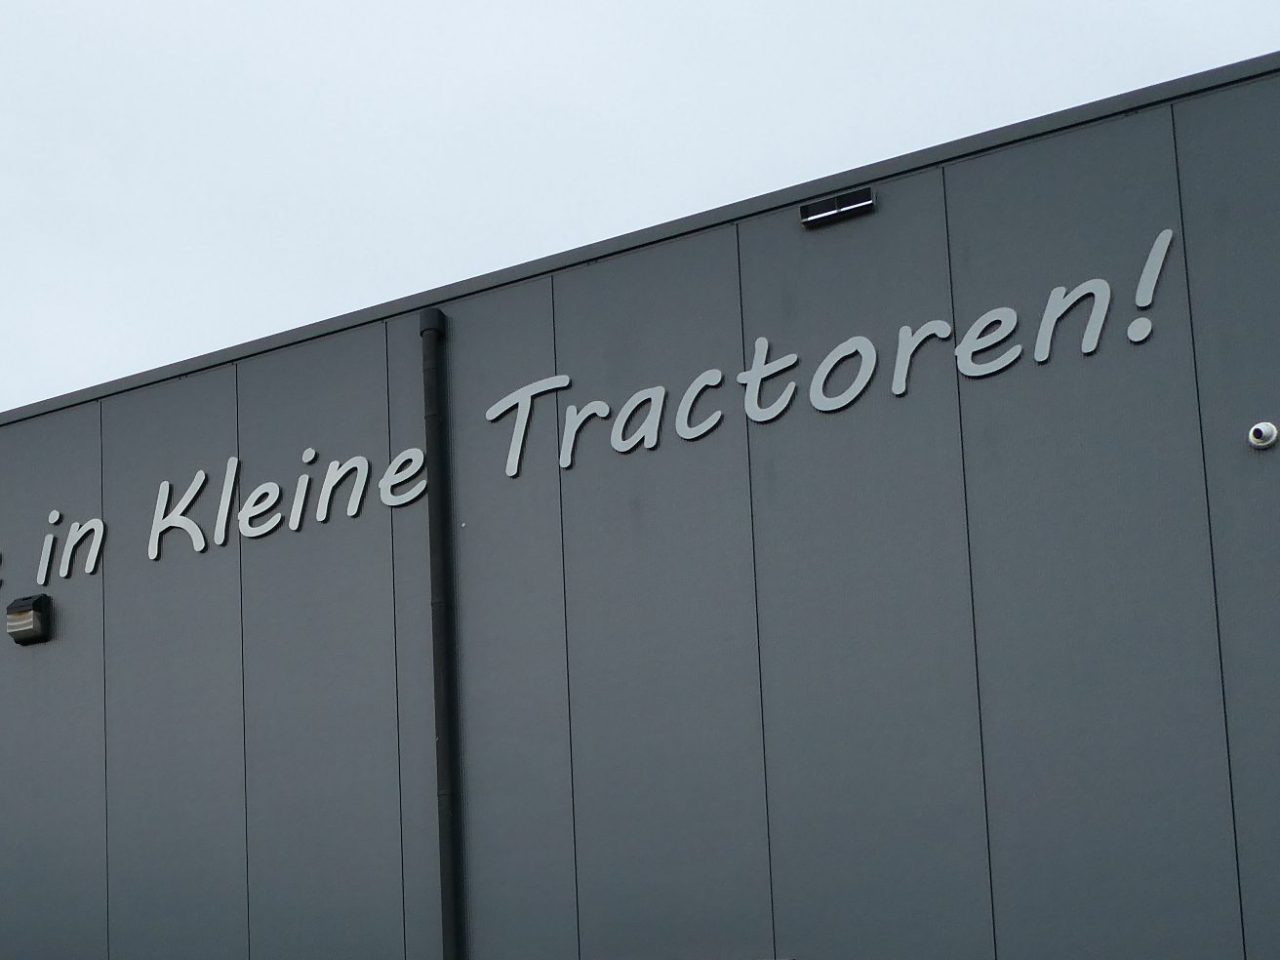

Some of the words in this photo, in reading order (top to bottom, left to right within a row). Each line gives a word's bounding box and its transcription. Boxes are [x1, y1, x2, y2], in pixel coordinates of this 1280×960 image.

[36, 509, 105, 586] in
[147, 447, 428, 561] Kleine
[485, 227, 1174, 478] Tractoren!
